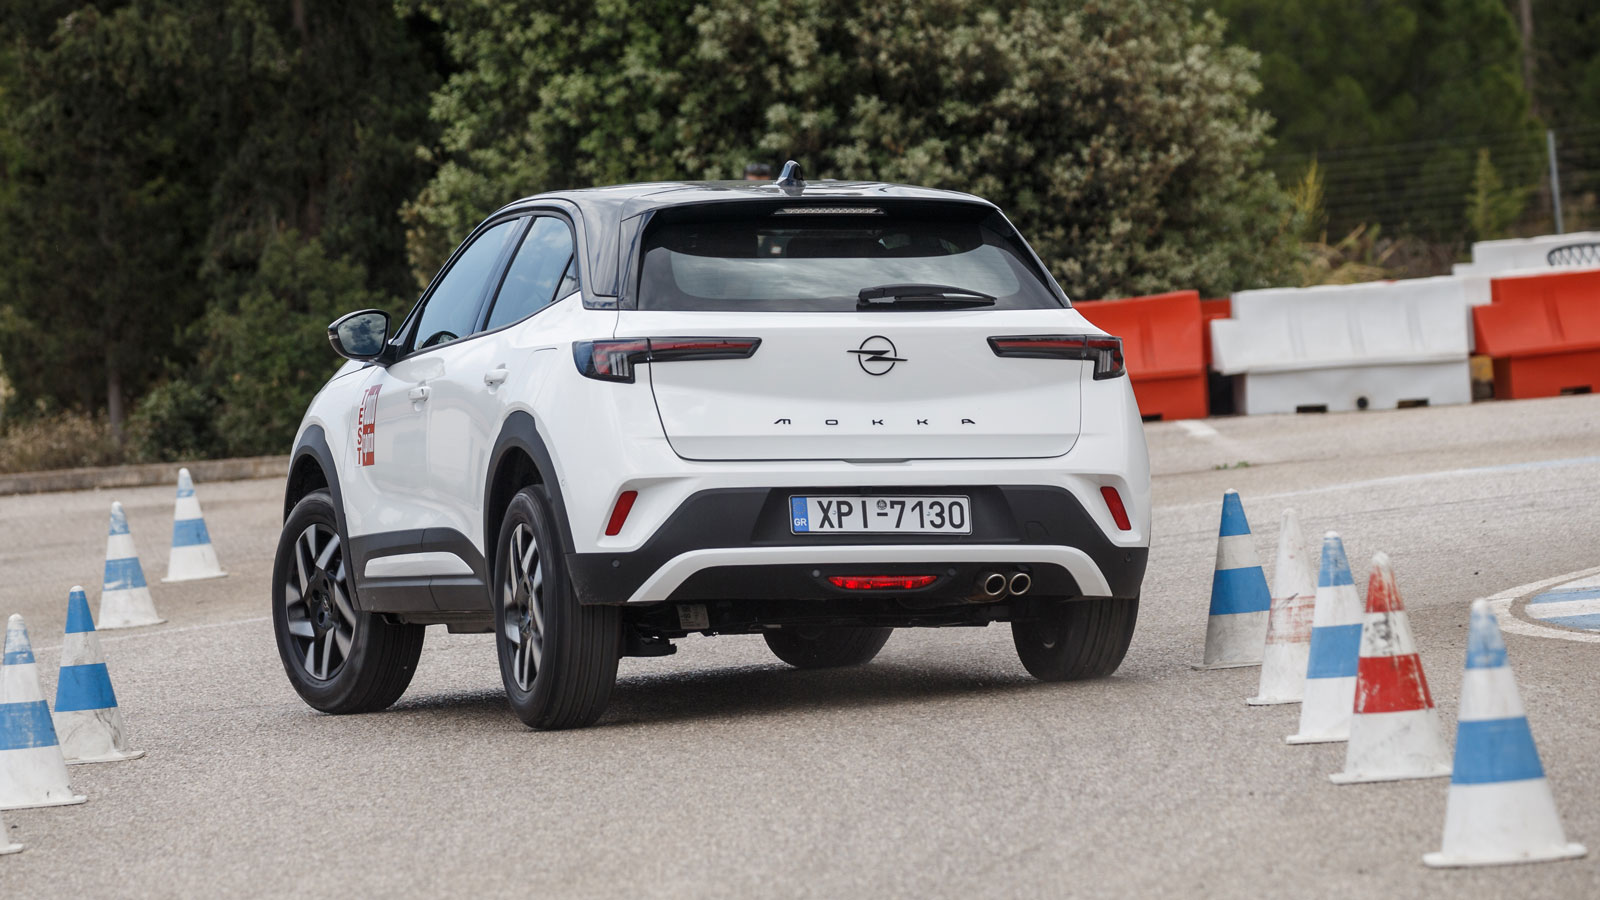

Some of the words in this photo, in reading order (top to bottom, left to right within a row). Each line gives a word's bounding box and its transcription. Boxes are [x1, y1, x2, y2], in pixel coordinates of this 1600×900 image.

[357, 388, 369, 465] TEST
[774, 418, 976, 426] MOKKA
[793, 517, 808, 527] GR
[816, 500, 966, 529] XPI-7130
